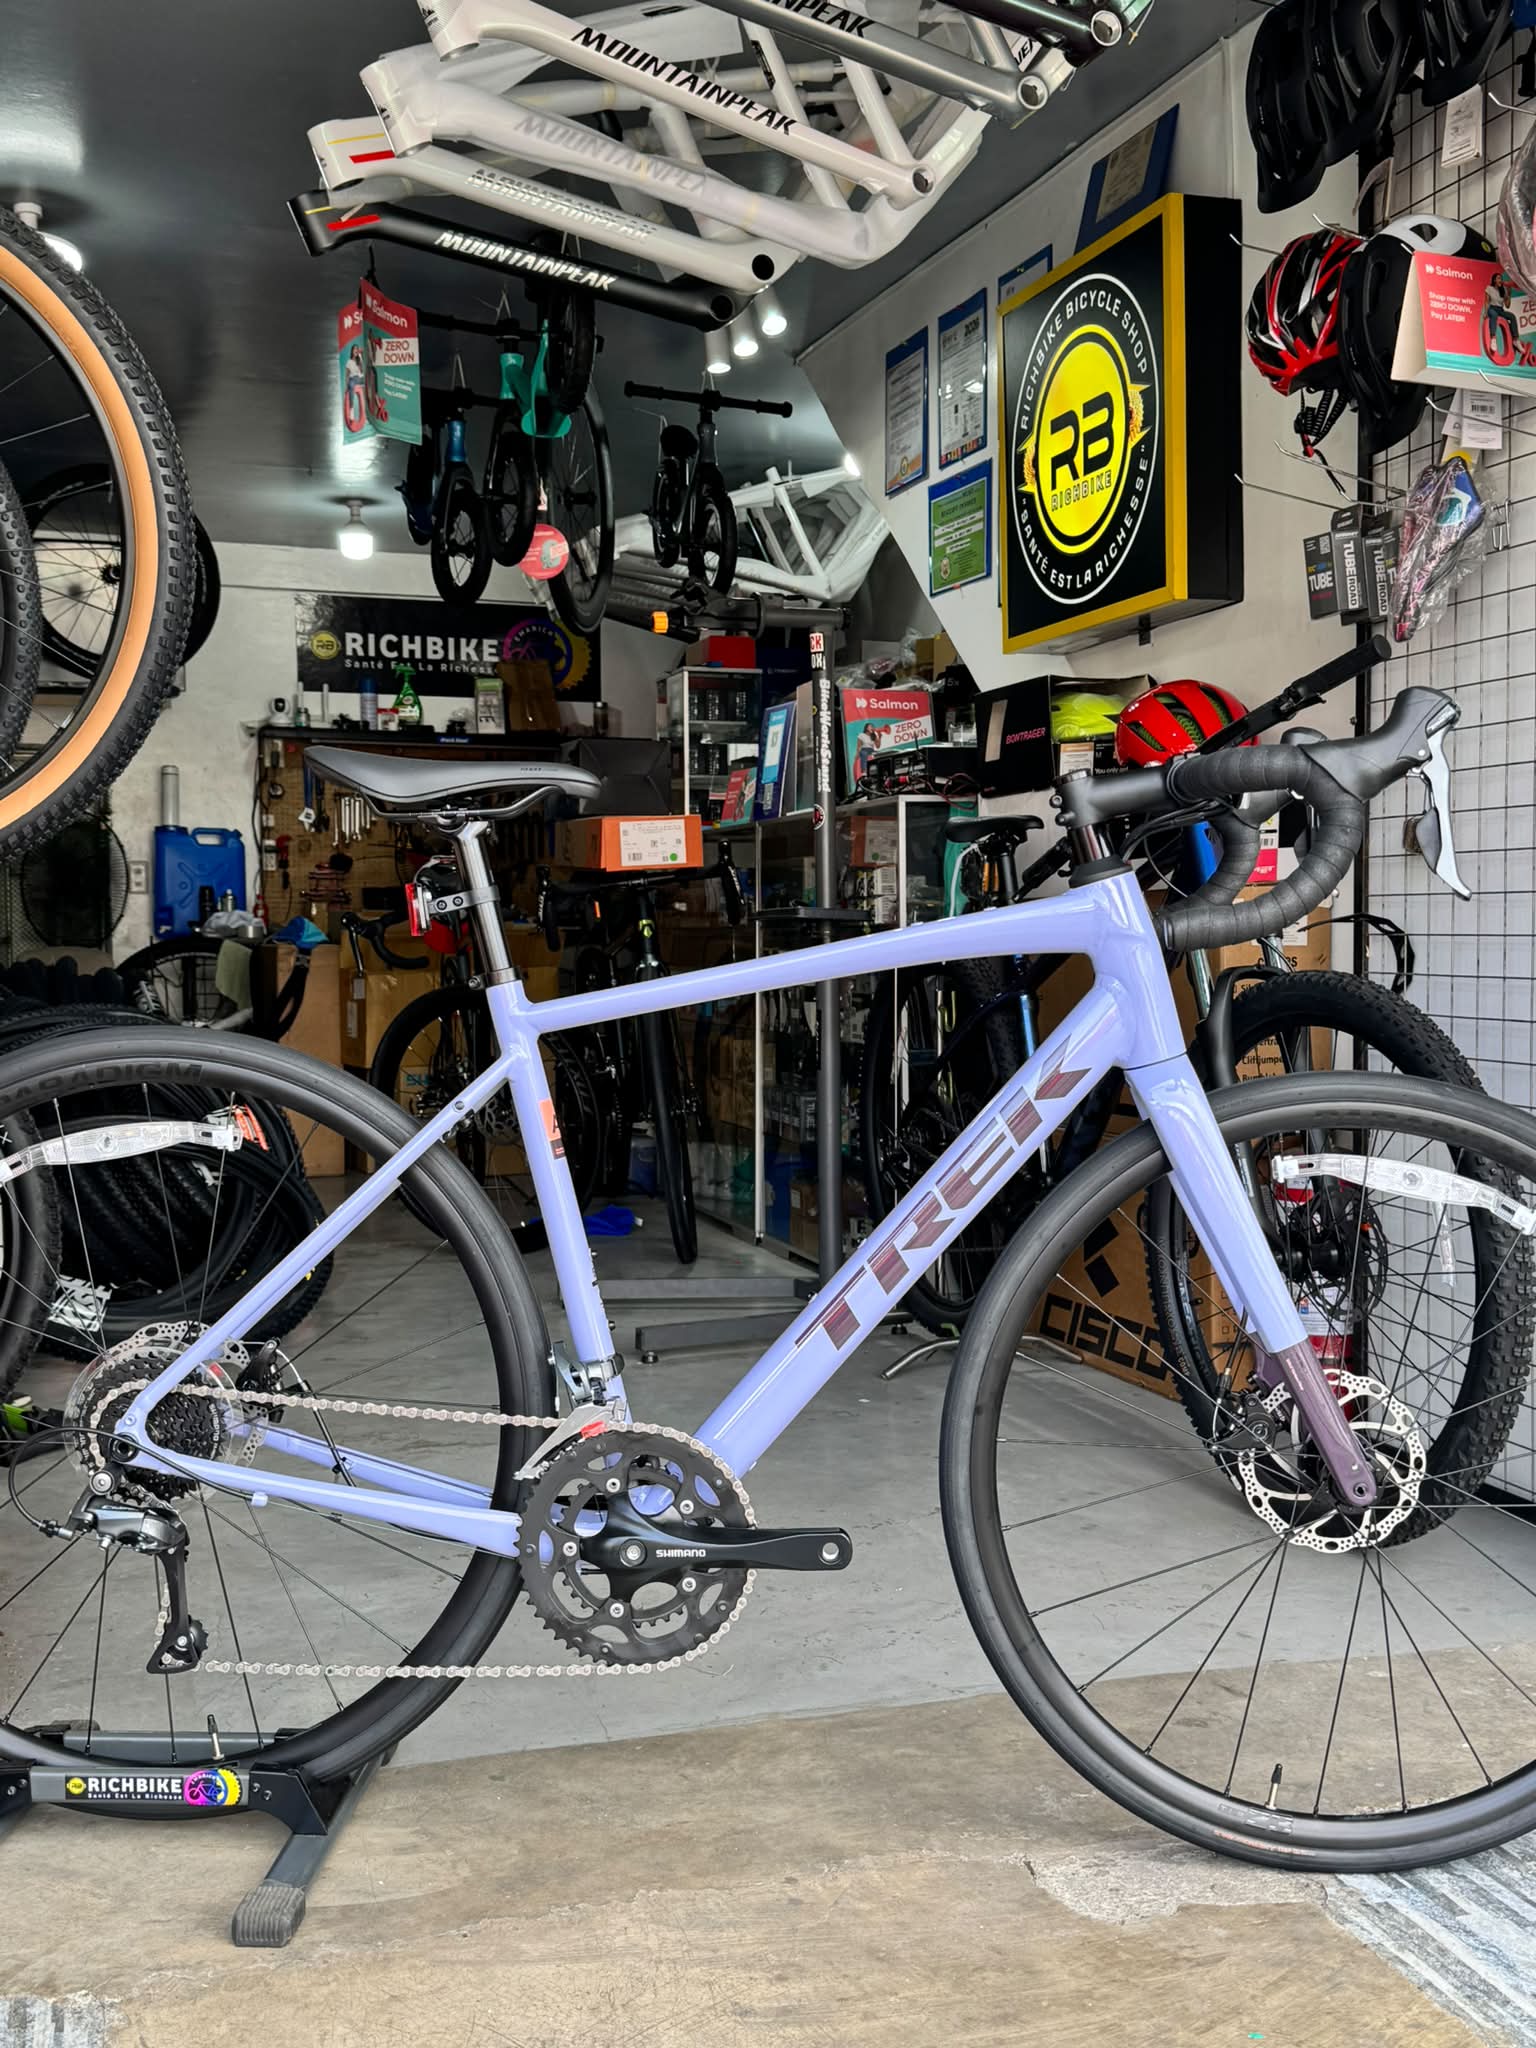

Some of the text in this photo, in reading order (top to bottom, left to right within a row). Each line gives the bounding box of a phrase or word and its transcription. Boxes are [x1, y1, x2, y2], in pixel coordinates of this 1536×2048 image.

[571, 27, 797, 135] MOUNTAINPEAK
[513, 113, 707, 193] MOUNTANPEA
[434, 231, 618, 291] MOUNTAINPEAK
[1435, 266, 1473, 280] Salmon
[372, 299, 408, 328] Salmon
[1523, 301, 1536, 313] ZE
[385, 339, 410, 351] ZERO
[384, 352, 416, 364] DOWN
[1020, 313, 1063, 430] RICHBIKE
[1065, 290, 1121, 320] BICYCLE
[1121, 311, 1148, 374] SHOP
[1051, 391, 1114, 491] RB
[1051, 470, 1112, 512] RICHBIKE
[1343, 540, 1357, 576] TUBE
[1050, 568, 1073, 590] EST
[1076, 571, 1092, 590] LA
[1309, 571, 1333, 591] TUBE
[1373, 547, 1389, 616] TUBE ROAD
[1347, 576, 1359, 610] ROAD
[344, 632, 500, 663] RICHBIKE
[418, 663, 434, 672] La
[440, 664, 501, 676] Richess
[870, 698, 919, 711] Salmon
[894, 728, 928, 744] DOWN
[895, 719, 921, 733] ZERO
[1005, 727, 1046, 745] BONTRAGER
[794, 1035, 1092, 1350] TREK
[655, 1547, 706, 1558] SHIMANO
[87, 1777, 182, 1793] RICHBIKE
